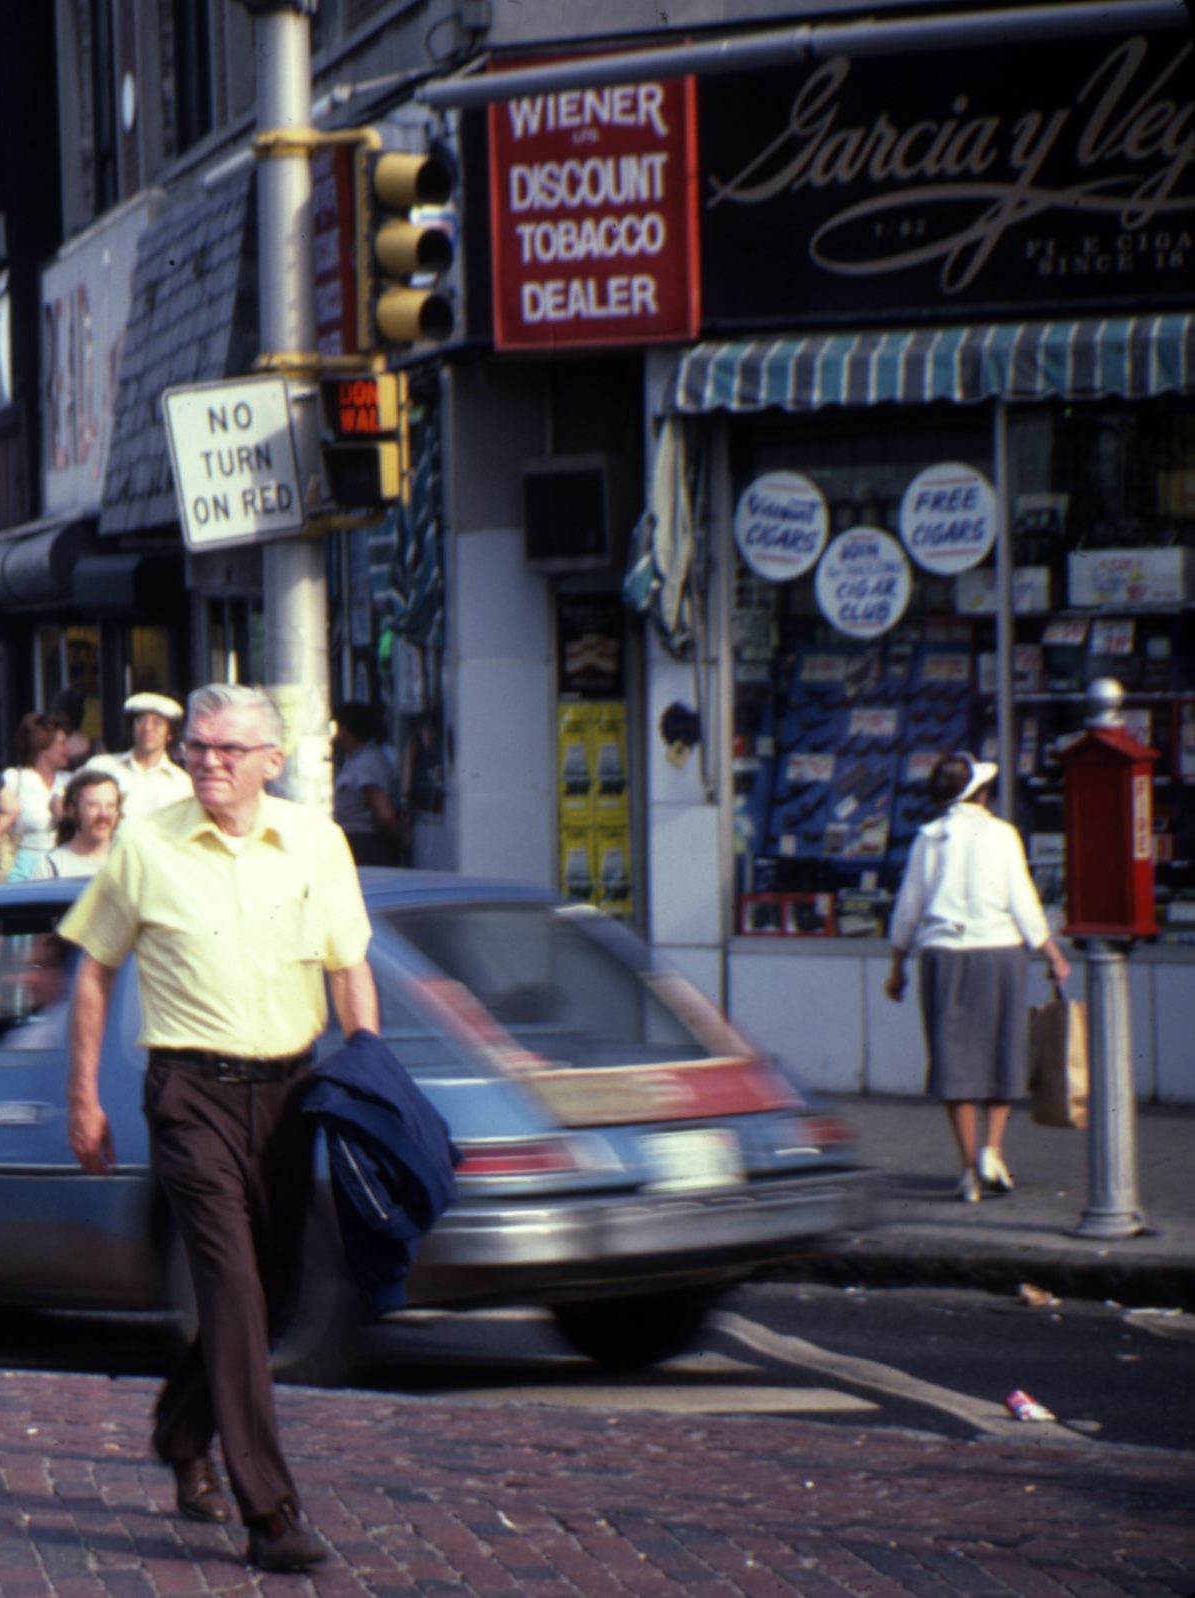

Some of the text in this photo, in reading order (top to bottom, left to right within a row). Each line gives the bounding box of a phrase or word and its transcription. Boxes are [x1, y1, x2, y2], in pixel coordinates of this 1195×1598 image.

[508, 82, 668, 140] WIENER
[707, 55, 1001, 210] Garcia
[1076, 36, 1194, 230] Veg
[510, 152, 668, 212] DISCOUNT
[515, 213, 666, 265] TOBACCO
[1117, 230, 1194, 252] CIGA
[521, 274, 659, 324] DEALER
[339, 381, 380, 406] DON
[208, 402, 252, 434] NO
[340, 407, 380, 433] WAL
[200, 443, 272, 478] TURN
[193, 483, 293, 524] ON RED
[914, 486, 980, 514] FREE
[745, 521, 819, 552] CIGARS
[911, 516, 985, 547] CIGARS
[836, 577, 899, 599] CIGAR
[839, 601, 890, 623] CLUB
